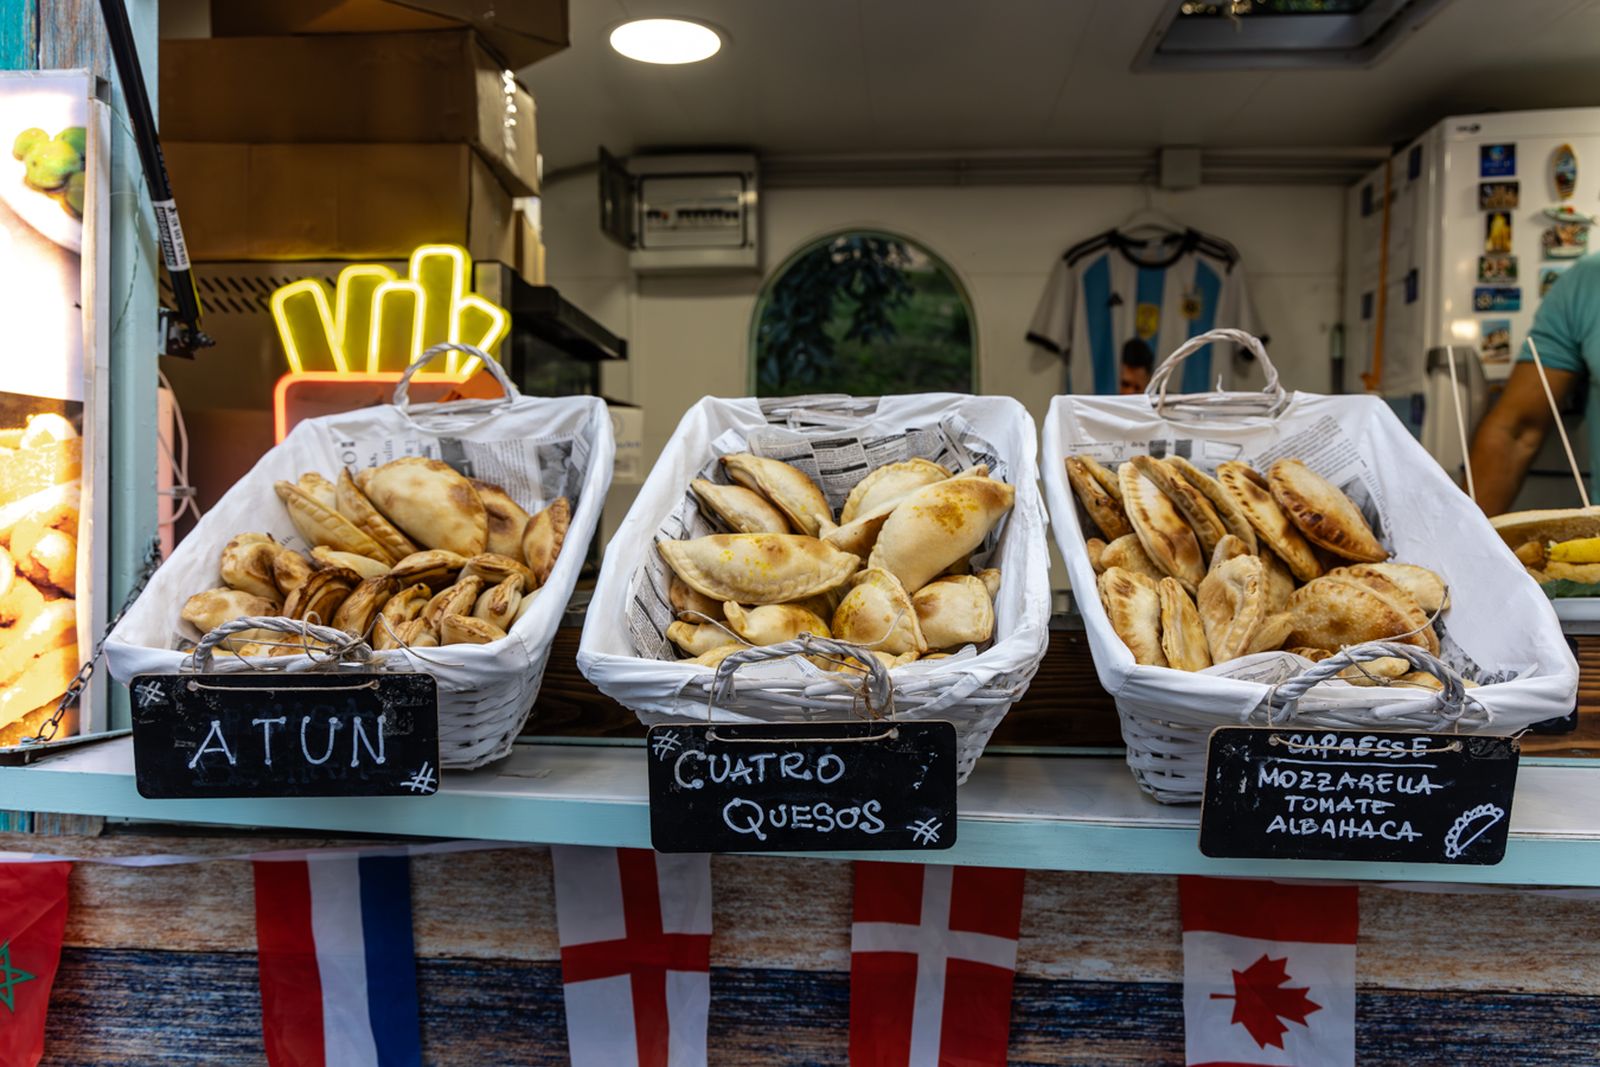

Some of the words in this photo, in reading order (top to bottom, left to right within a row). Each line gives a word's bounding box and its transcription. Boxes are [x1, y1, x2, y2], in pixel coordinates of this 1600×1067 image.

[188, 715, 387, 768] ATUN
[1287, 732, 1433, 760] CAPRESSE
[674, 750, 846, 789] CUATRO
[1257, 766, 1445, 796] MOZZARELLA
[722, 797, 886, 841] QUESOS
[1284, 794, 1396, 816] TOMATE
[1265, 814, 1424, 842] ALBAHACA
